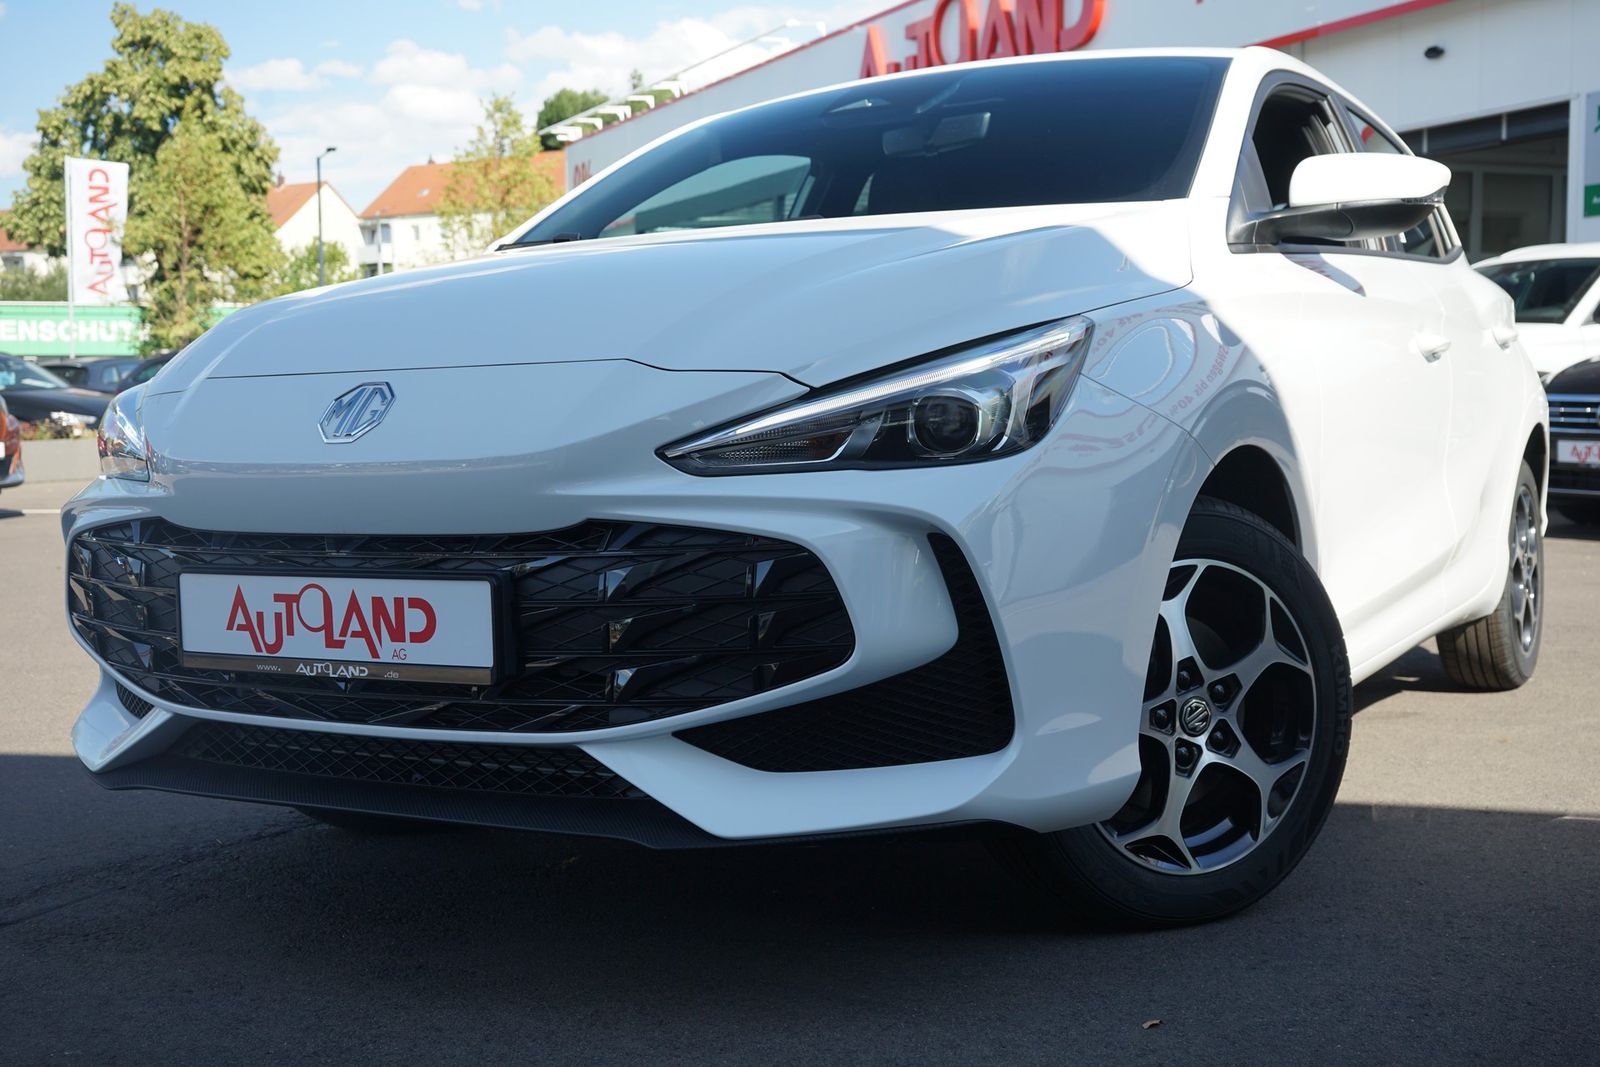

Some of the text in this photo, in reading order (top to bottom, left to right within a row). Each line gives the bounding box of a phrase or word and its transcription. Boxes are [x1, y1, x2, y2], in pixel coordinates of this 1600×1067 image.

[322, 384, 392, 441] MG
[226, 583, 438, 660] AUTOLAND
[256, 662, 399, 679] www. AUTOLAND .de
[391, 648, 408, 661] AG
